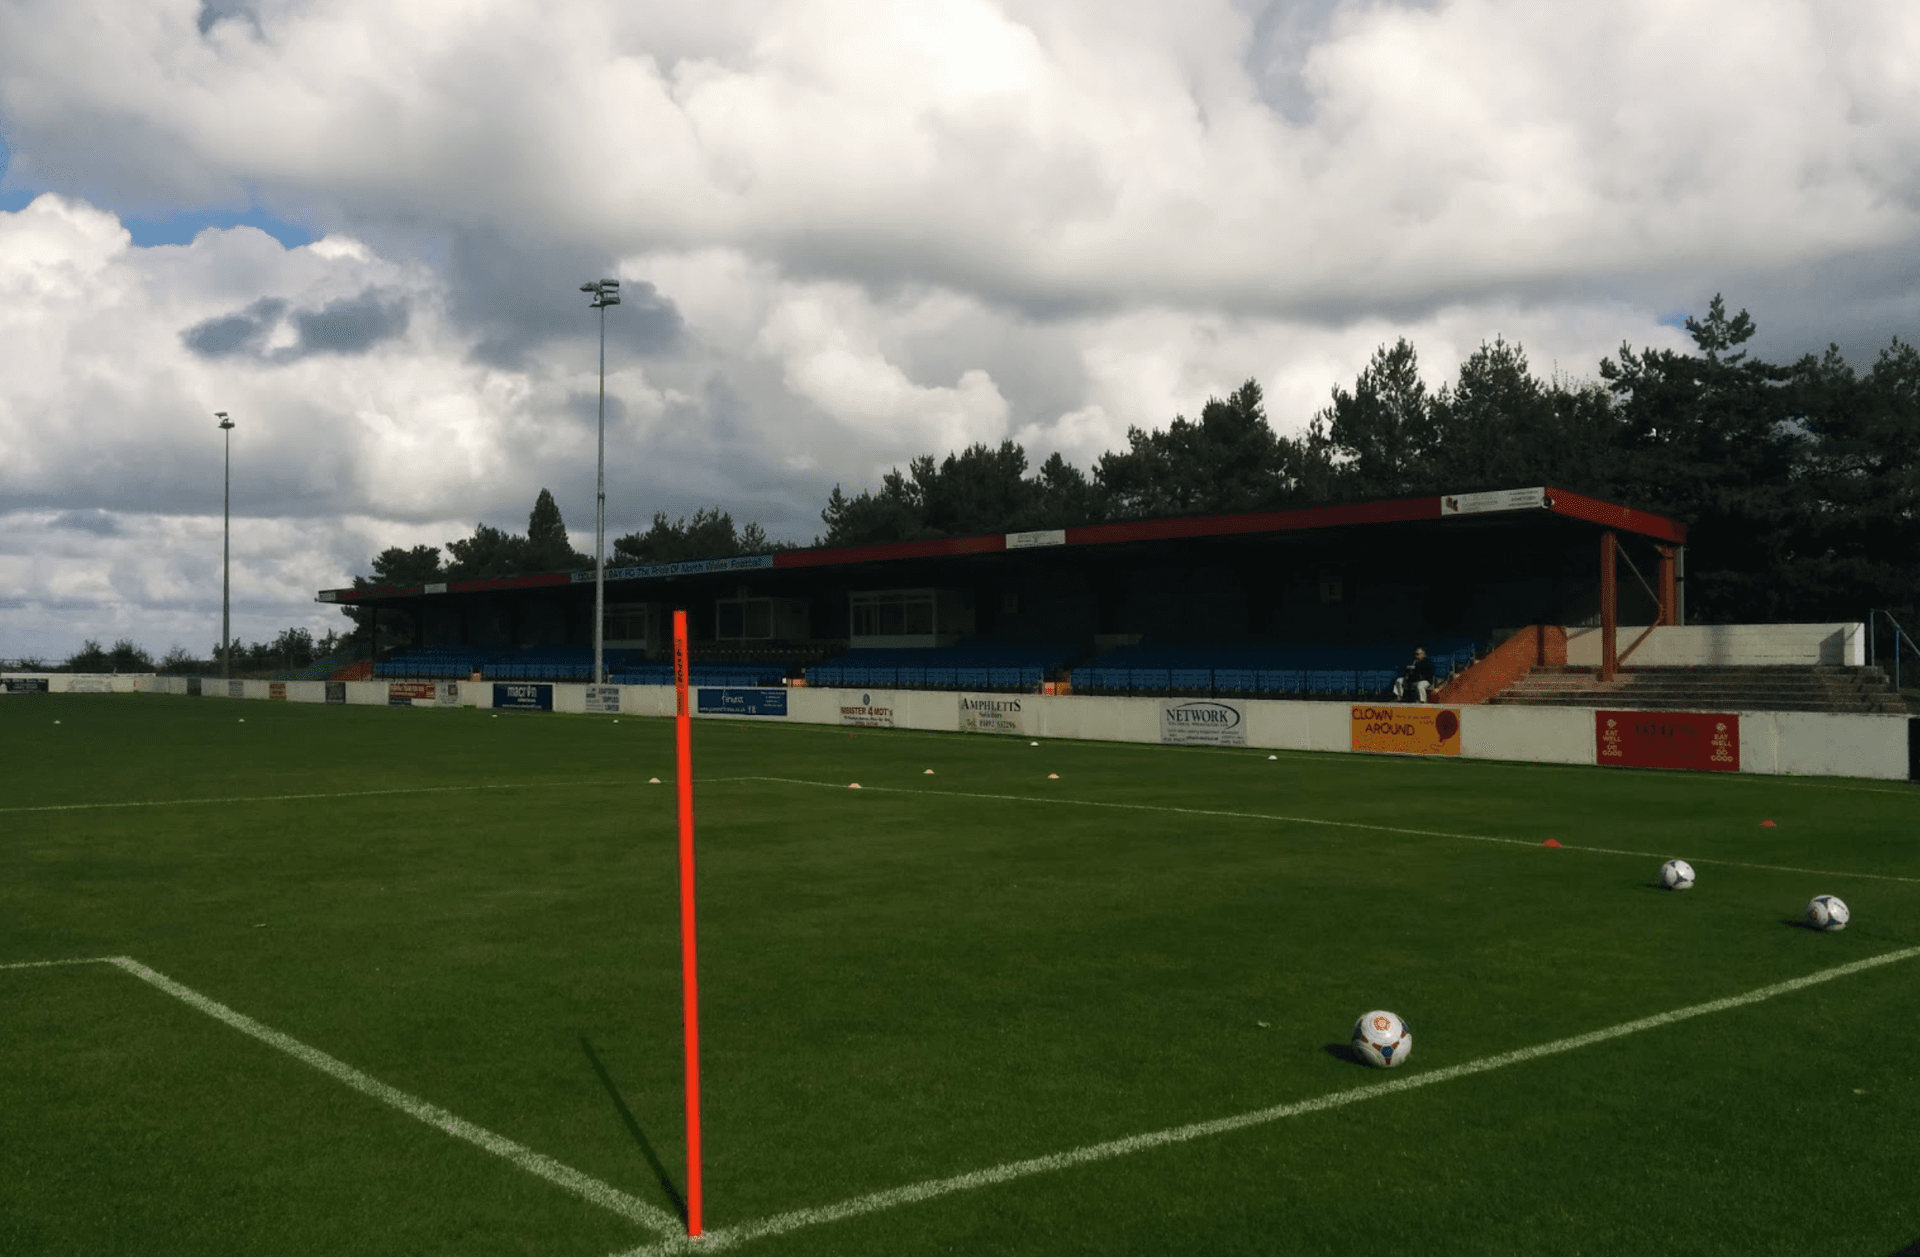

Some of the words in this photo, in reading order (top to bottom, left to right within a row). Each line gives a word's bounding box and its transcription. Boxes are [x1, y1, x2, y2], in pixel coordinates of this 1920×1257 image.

[961, 697, 1022, 712] AMPHLETTS
[1166, 708, 1229, 723] NETWORK
[1351, 707, 1393, 721] CLOWN
[1365, 722, 1416, 737] AROUND
[1602, 735, 1622, 743] WELL
[1711, 739, 1733, 748] WELL
[1710, 755, 1734, 763] GOOD
